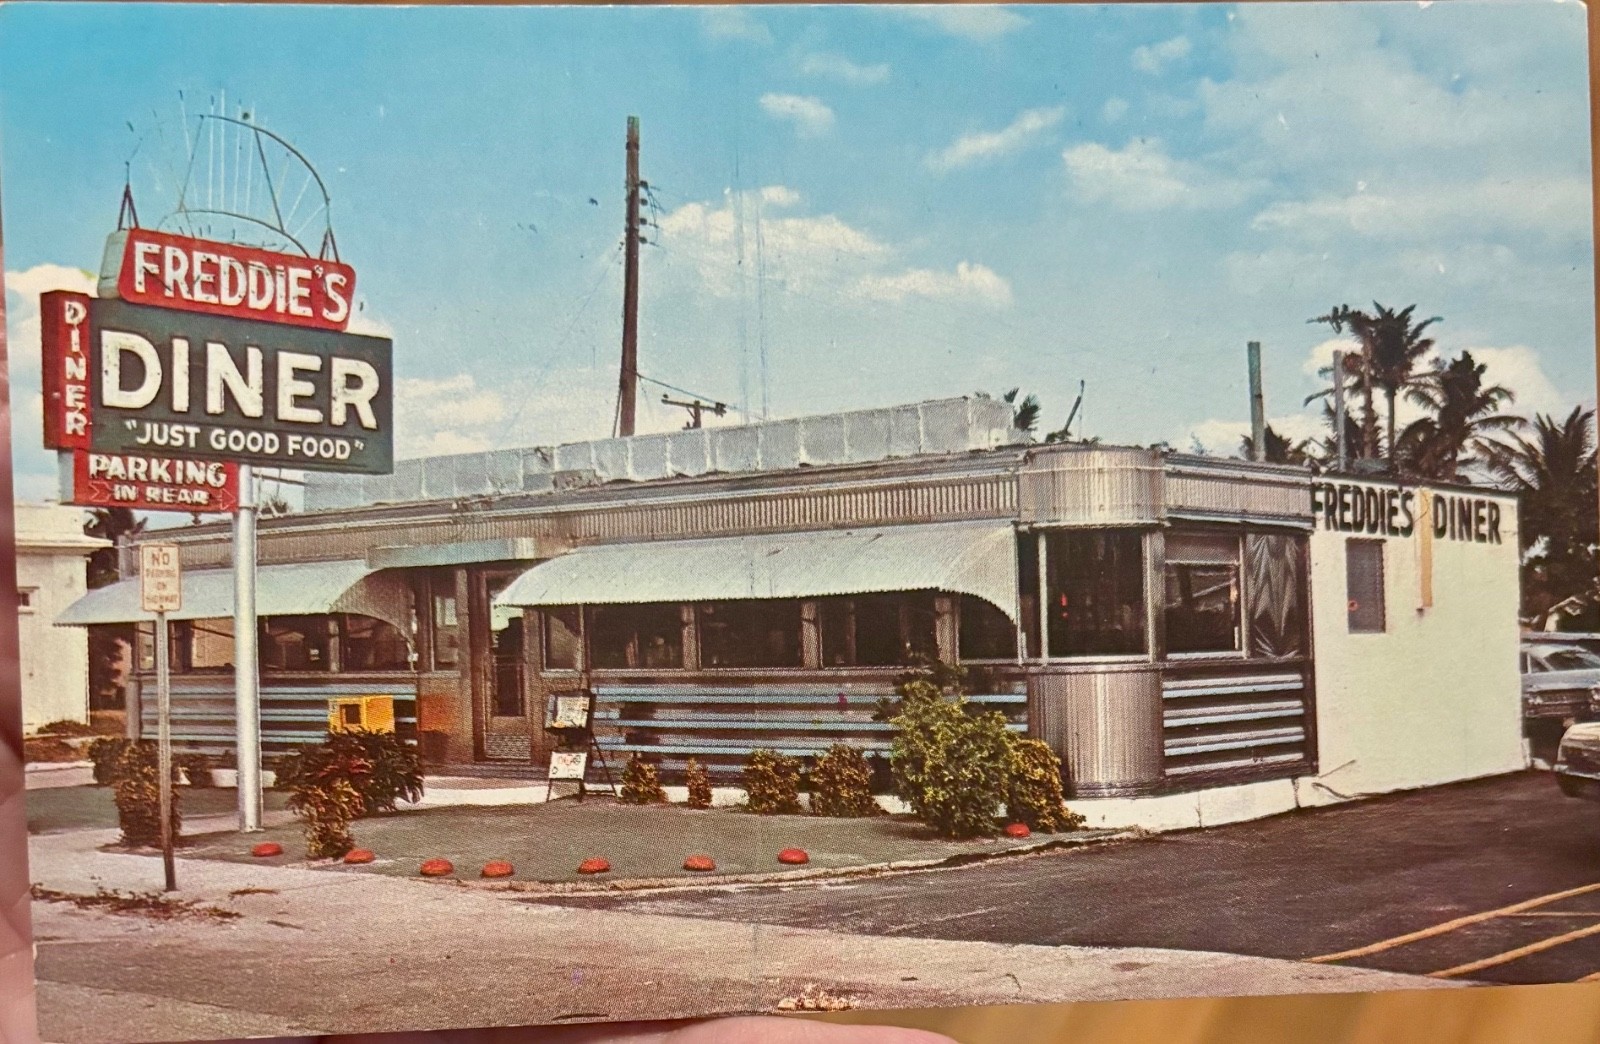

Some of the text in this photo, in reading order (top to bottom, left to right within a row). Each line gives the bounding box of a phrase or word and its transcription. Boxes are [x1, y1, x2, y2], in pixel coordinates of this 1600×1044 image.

[134, 241, 349, 323] FREDDIE'S
[64, 300, 88, 436] DINER
[100, 329, 378, 430] DINER
[209, 428, 280, 456] GOOD
[88, 454, 228, 488] PARKING
[113, 484, 209, 505] IN REAR
[1311, 482, 1502, 545] FREDDIES DINER
[151, 552, 170, 566] NO
